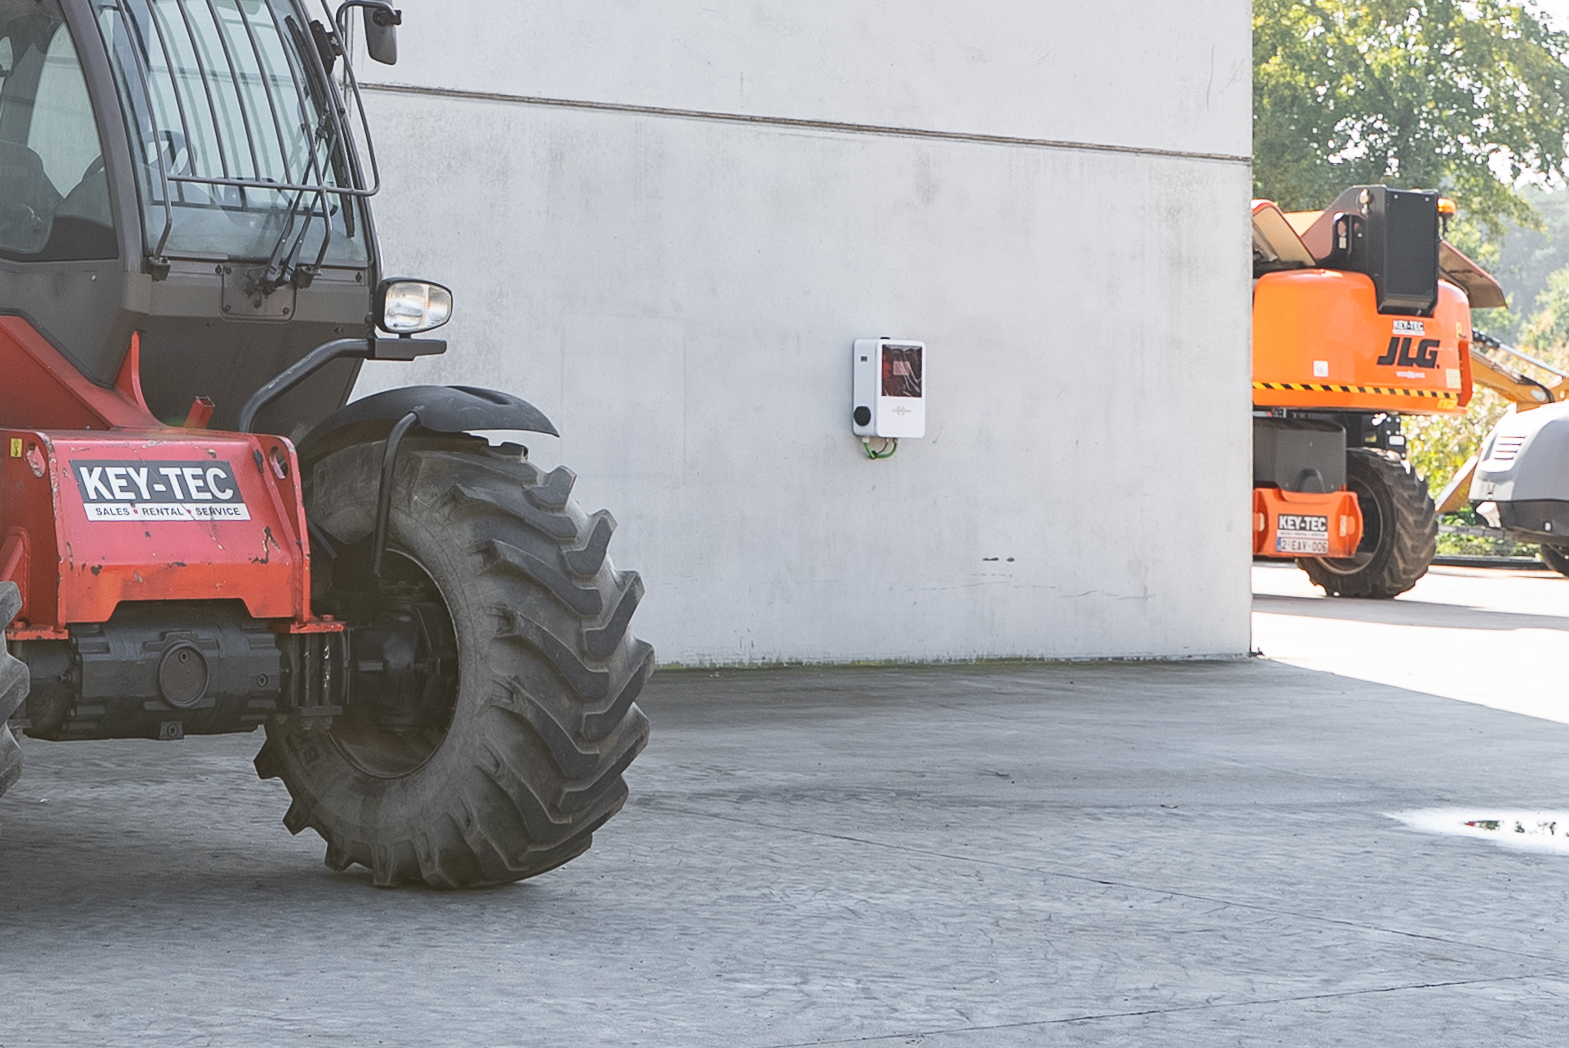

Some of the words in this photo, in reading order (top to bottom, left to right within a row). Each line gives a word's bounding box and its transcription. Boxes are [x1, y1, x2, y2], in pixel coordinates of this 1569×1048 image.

[79, 466, 234, 500] KEY-TEC
[95, 507, 130, 517] SALES
[142, 507, 184, 517] RENTAL
[195, 507, 241, 517] SERVICE
[1279, 515, 1327, 531] KEY-TEC
